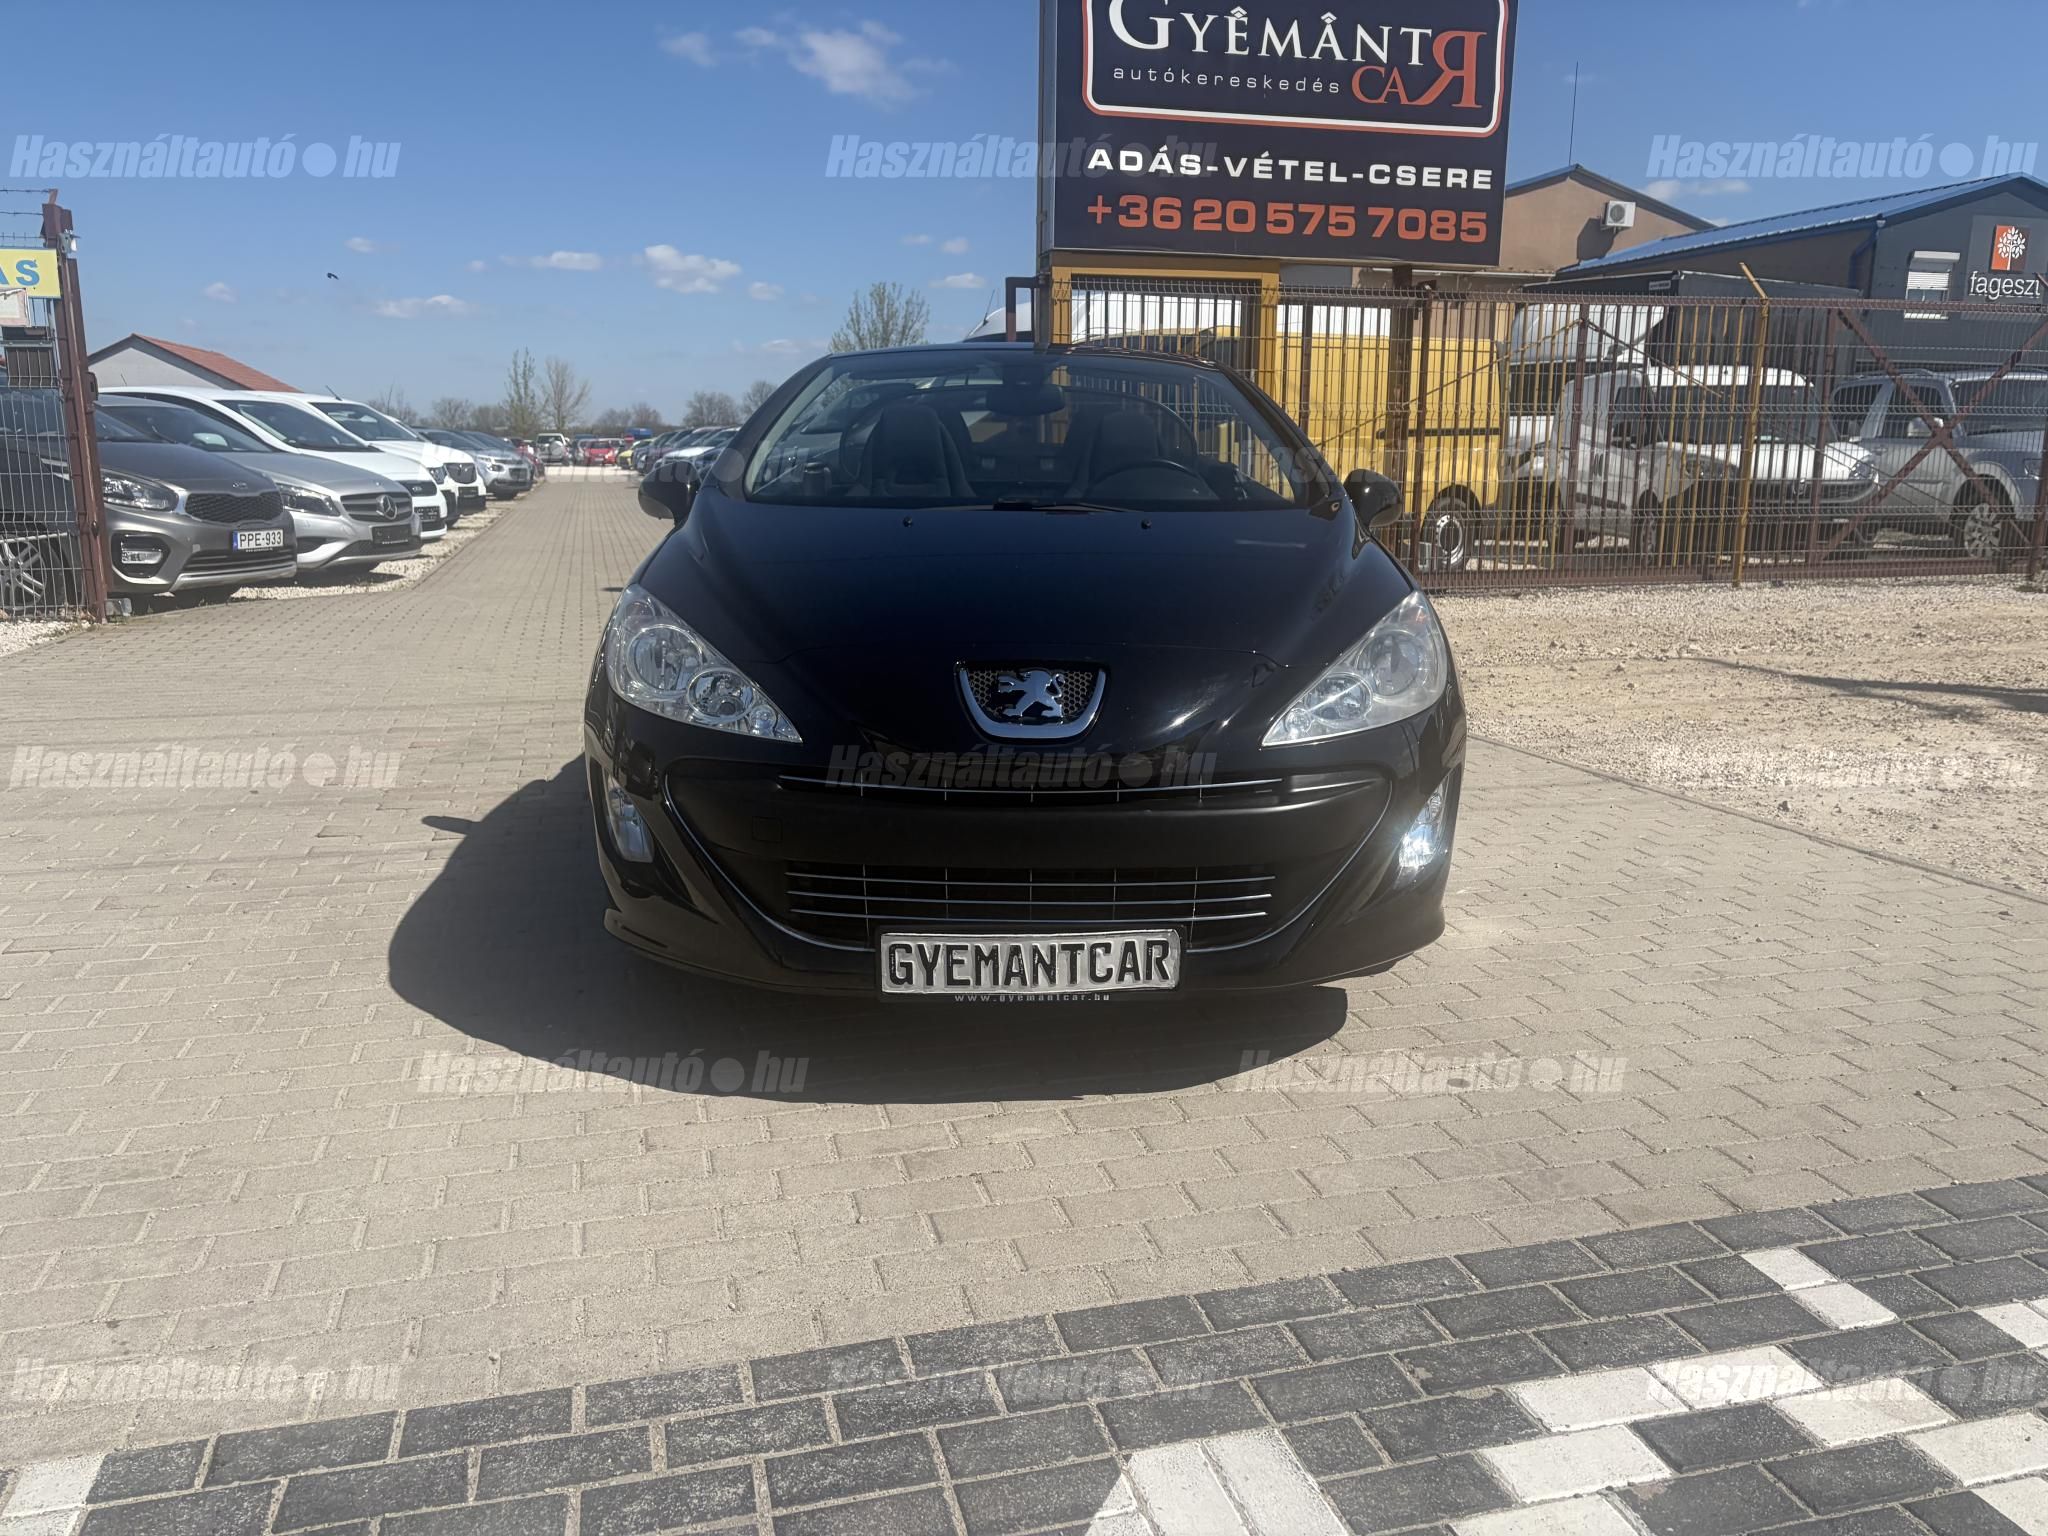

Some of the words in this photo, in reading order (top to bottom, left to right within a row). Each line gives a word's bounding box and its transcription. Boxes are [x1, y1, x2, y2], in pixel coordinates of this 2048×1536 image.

[1113, 67, 1339, 93] autókereskedés
[1087, 194, 1182, 230] +36
[1193, 198, 1257, 233] 20
[1265, 202, 1357, 238] 575
[1367, 207, 1488, 243] 7085
[239, 530, 283, 548] PPE-933
[888, 939, 1170, 987] GYEMANTCAR
